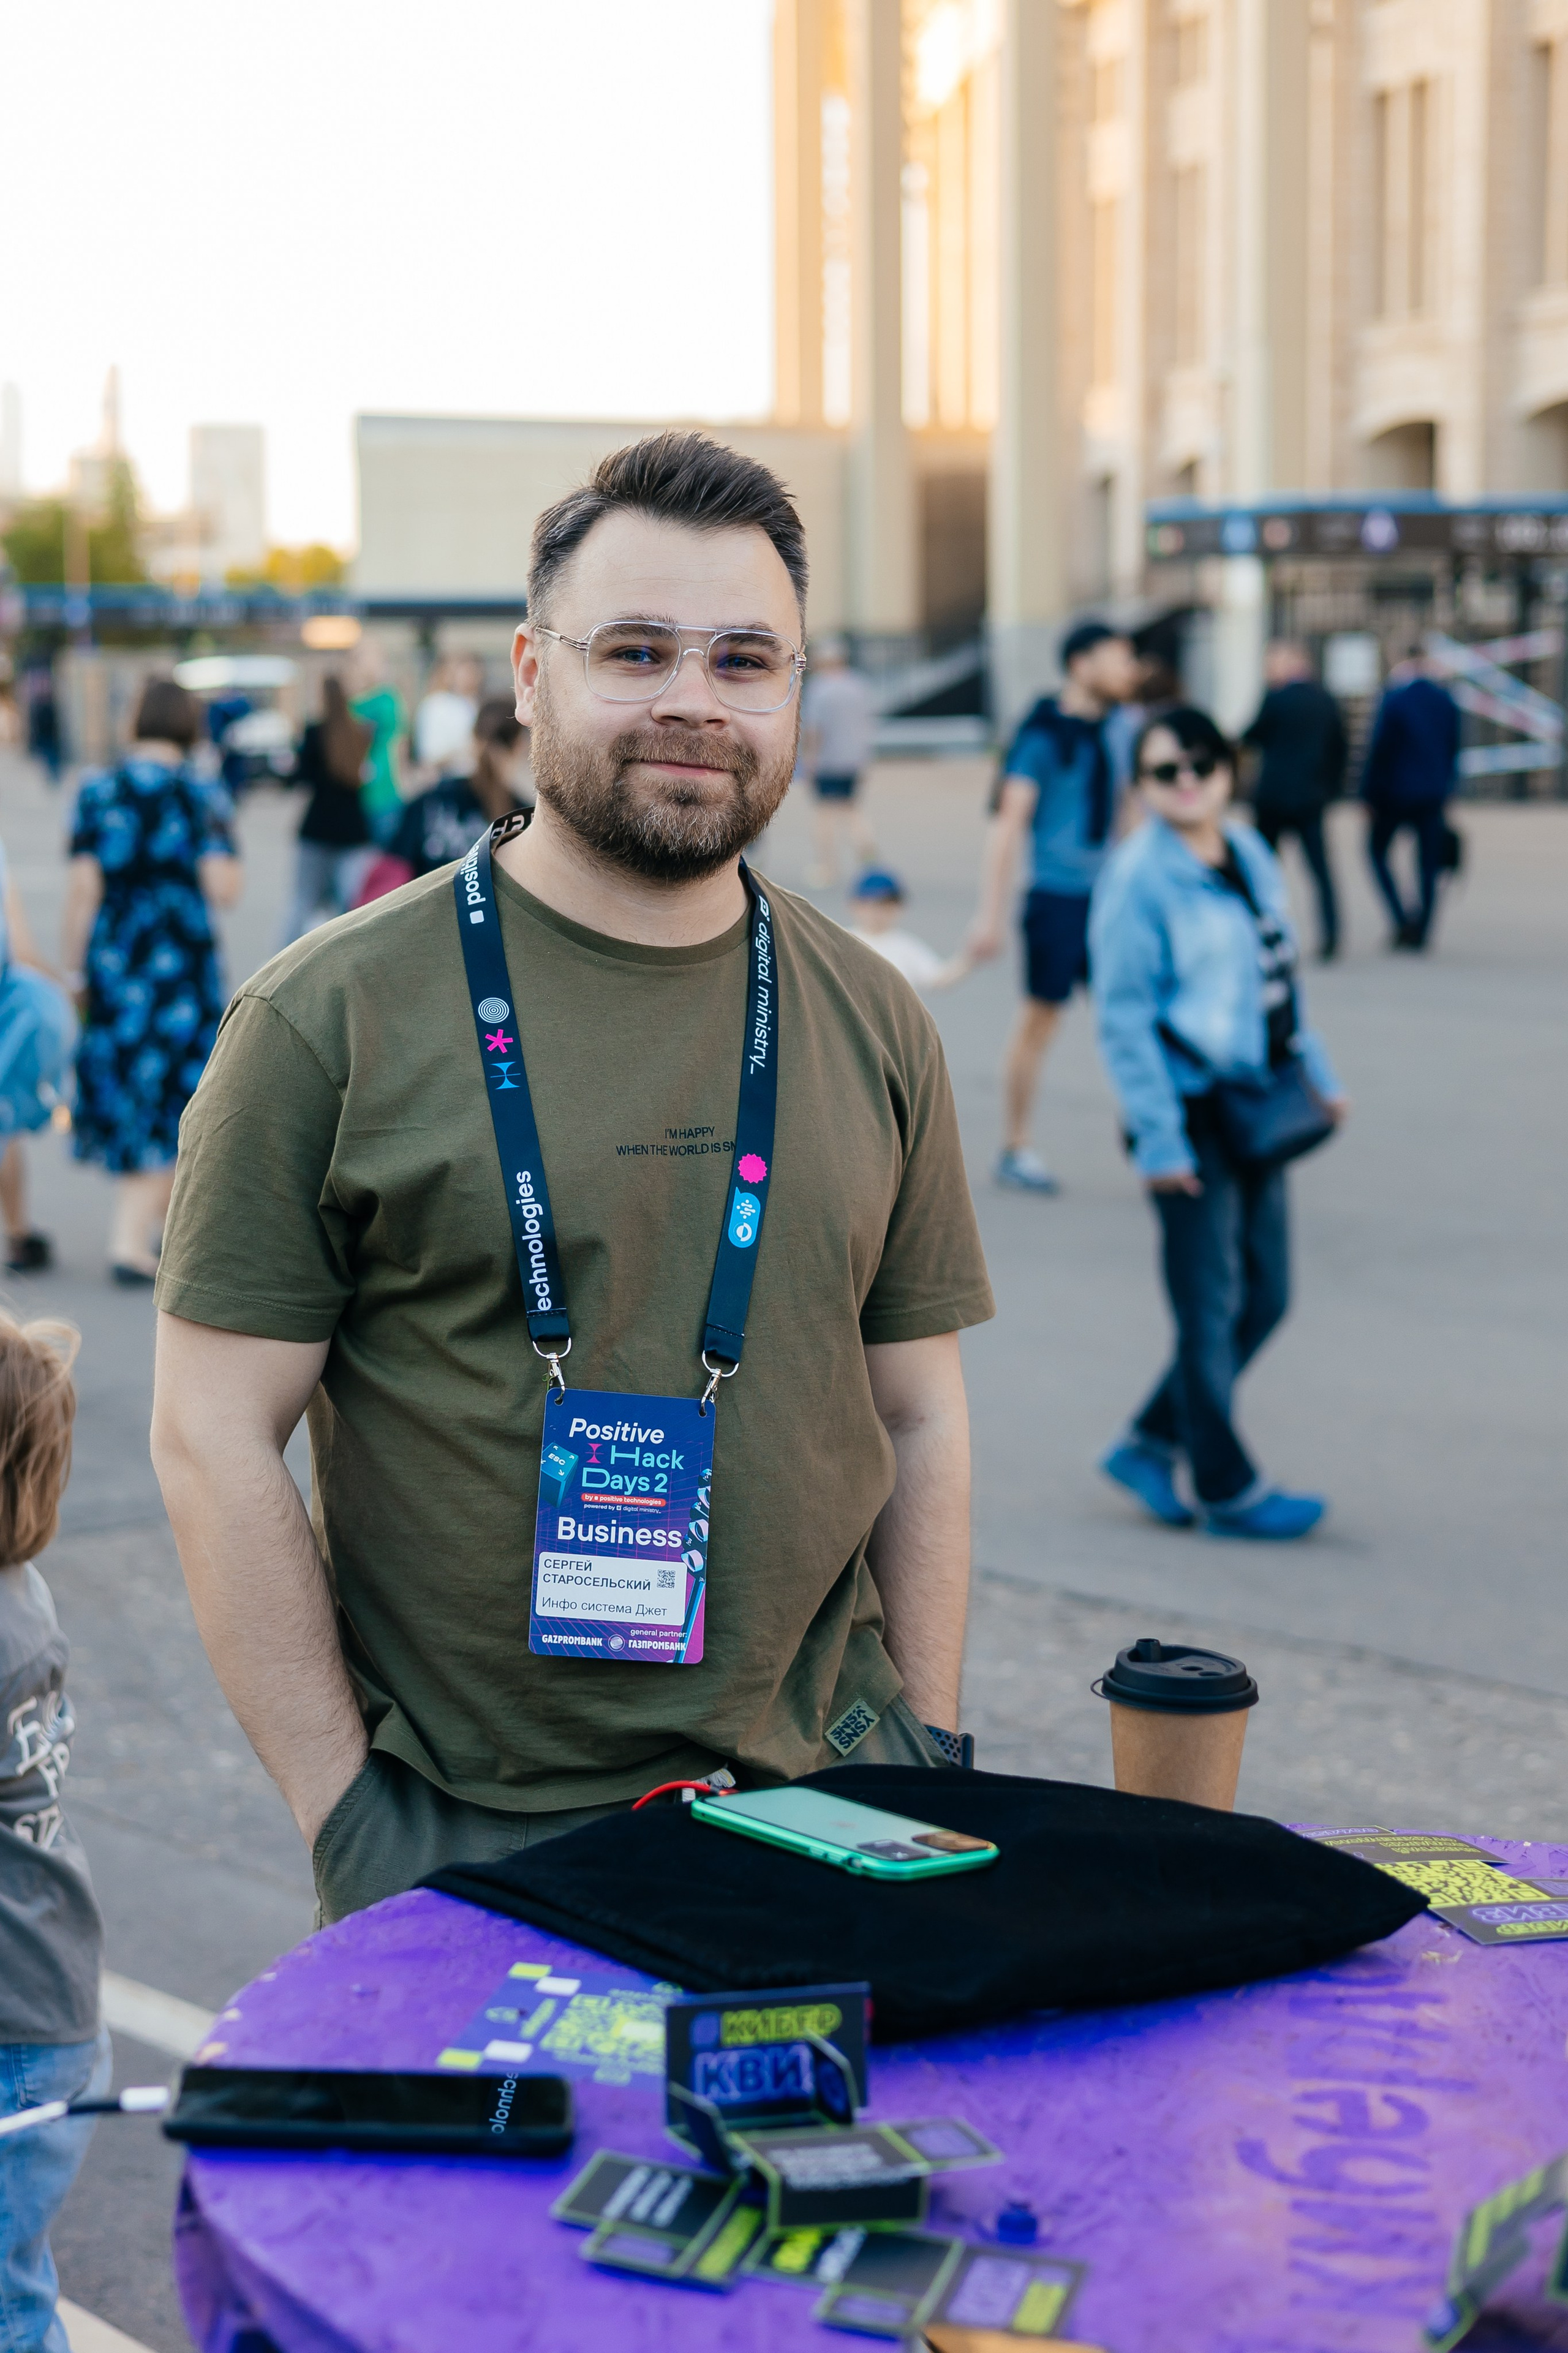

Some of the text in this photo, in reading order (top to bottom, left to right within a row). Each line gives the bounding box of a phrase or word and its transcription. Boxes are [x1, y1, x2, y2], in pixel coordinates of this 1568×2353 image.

[460, 844, 486, 905] positive
[755, 921, 772, 984] digital
[665, 1126, 715, 1139] I'M HAPPY
[616, 1144, 649, 1156] WHEN
[649, 1144, 668, 1156] THE
[668, 1143, 709, 1156] WORLD
[710, 1142, 722, 1154] IS
[515, 1170, 552, 1311] echnologies
[568, 1417, 665, 1445] Positive
[548, 1452, 566, 1466] ESC
[610, 1445, 685, 1470] Hack
[581, 1467, 668, 1496] Days 2
[584, 1494, 662, 1506] by positive technologies
[557, 1516, 682, 1548] Business
[543, 1558, 592, 1572] СЕРГЕЙ
[542, 1573, 651, 1591] СТАРОСЕЛЬСКИЙ
[541, 1596, 668, 1617] Инфо система Джет
[541, 1634, 603, 1647] GAZPROMBANK
[630, 1628, 688, 1639] general partner:
[628, 1638, 686, 1652] ГАЗПРОМБАНК
